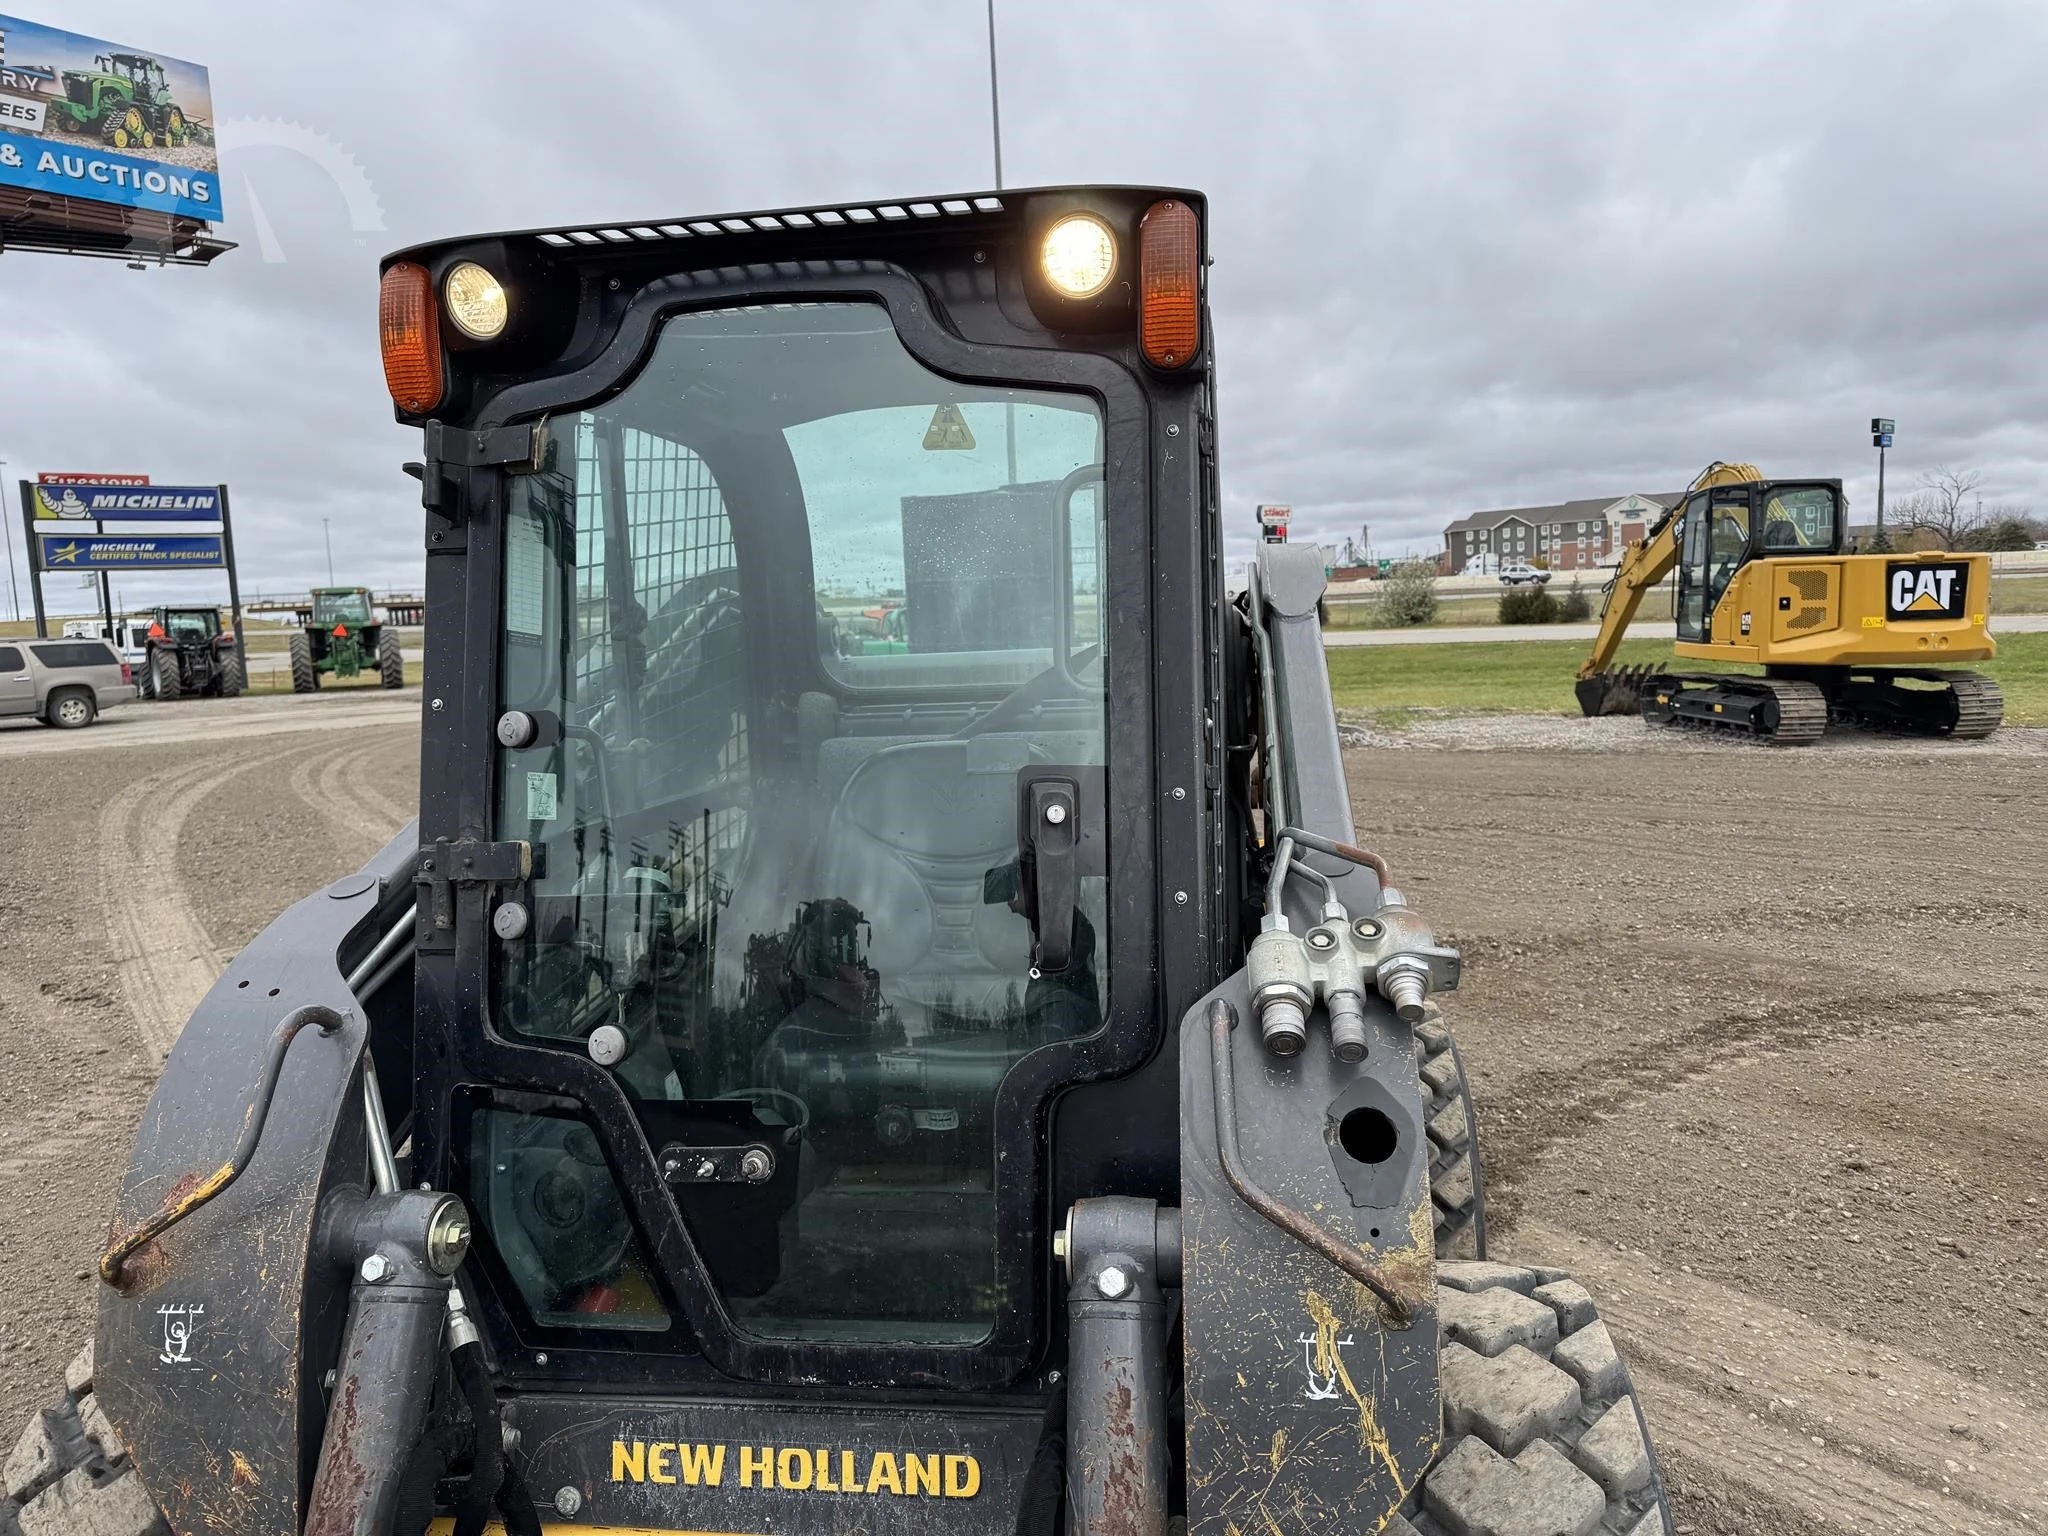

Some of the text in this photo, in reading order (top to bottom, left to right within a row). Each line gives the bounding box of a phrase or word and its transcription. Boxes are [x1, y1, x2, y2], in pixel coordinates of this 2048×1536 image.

[1, 143, 211, 202] & AUCTIONS
[92, 494, 214, 509] MICHELIN
[90, 543, 156, 551] MICHELIN
[90, 551, 219, 560] CERTIFIED TRUCK SPECIALIST
[1891, 569, 1957, 612] CAT
[612, 1440, 983, 1499] NEW HOLLAND
